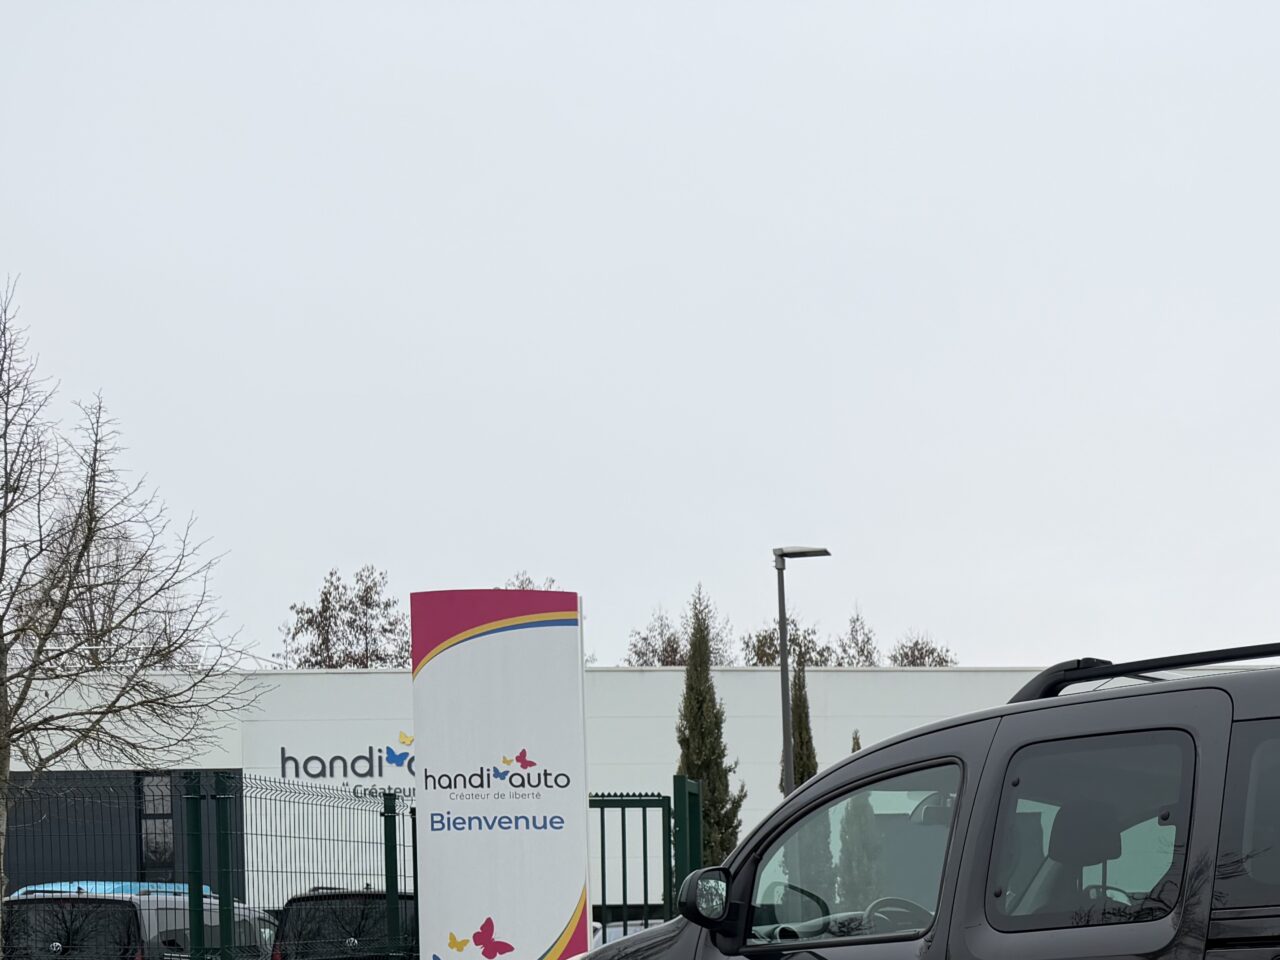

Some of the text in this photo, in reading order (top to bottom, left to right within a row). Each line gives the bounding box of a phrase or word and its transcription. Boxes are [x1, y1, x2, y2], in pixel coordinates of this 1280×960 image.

[449, 791, 541, 801] Créateur de liberté
[430, 810, 565, 832] Bienvenue
